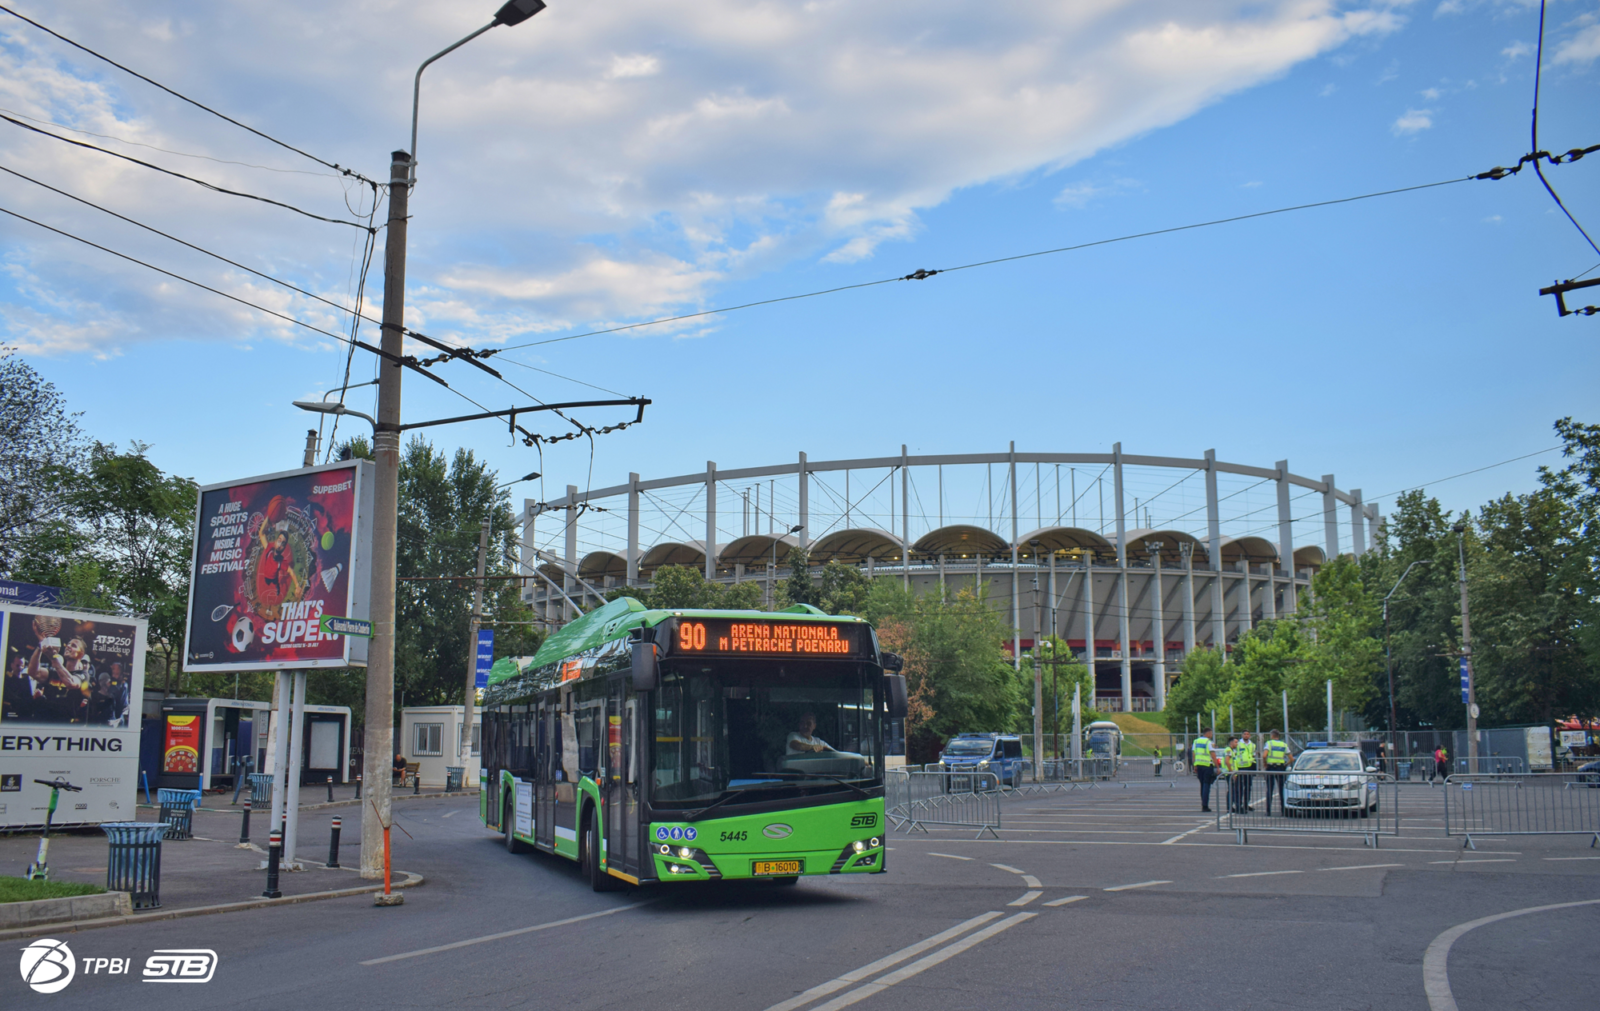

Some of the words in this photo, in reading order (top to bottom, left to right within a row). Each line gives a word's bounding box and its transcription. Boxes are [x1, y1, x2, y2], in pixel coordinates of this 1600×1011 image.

[312, 480, 352, 494] SUPERBET
[218, 503, 224, 514] A
[224, 501, 242, 513] HUGE
[210, 512, 249, 527] SPORTS
[212, 524, 244, 538] ARENA
[213, 538, 234, 550] INSIDE
[234, 537, 241, 548] A
[210, 548, 243, 562] MUSIC
[201, 559, 250, 575] FESTIVAL?
[280, 600, 324, 620] THAT'S
[680, 622, 706, 650] 90
[731, 624, 770, 638] ARENA
[773, 625, 838, 640] NATIONALA
[719, 637, 728, 650] M
[732, 637, 793, 652] PETRACHE
[796, 639, 849, 653] POENARU
[0, 735, 122, 752] ERYTHING
[850, 813, 877, 828] STB
[719, 830, 748, 842] 5445
[764, 863, 771, 871] B
[775, 862, 798, 871] 16010
